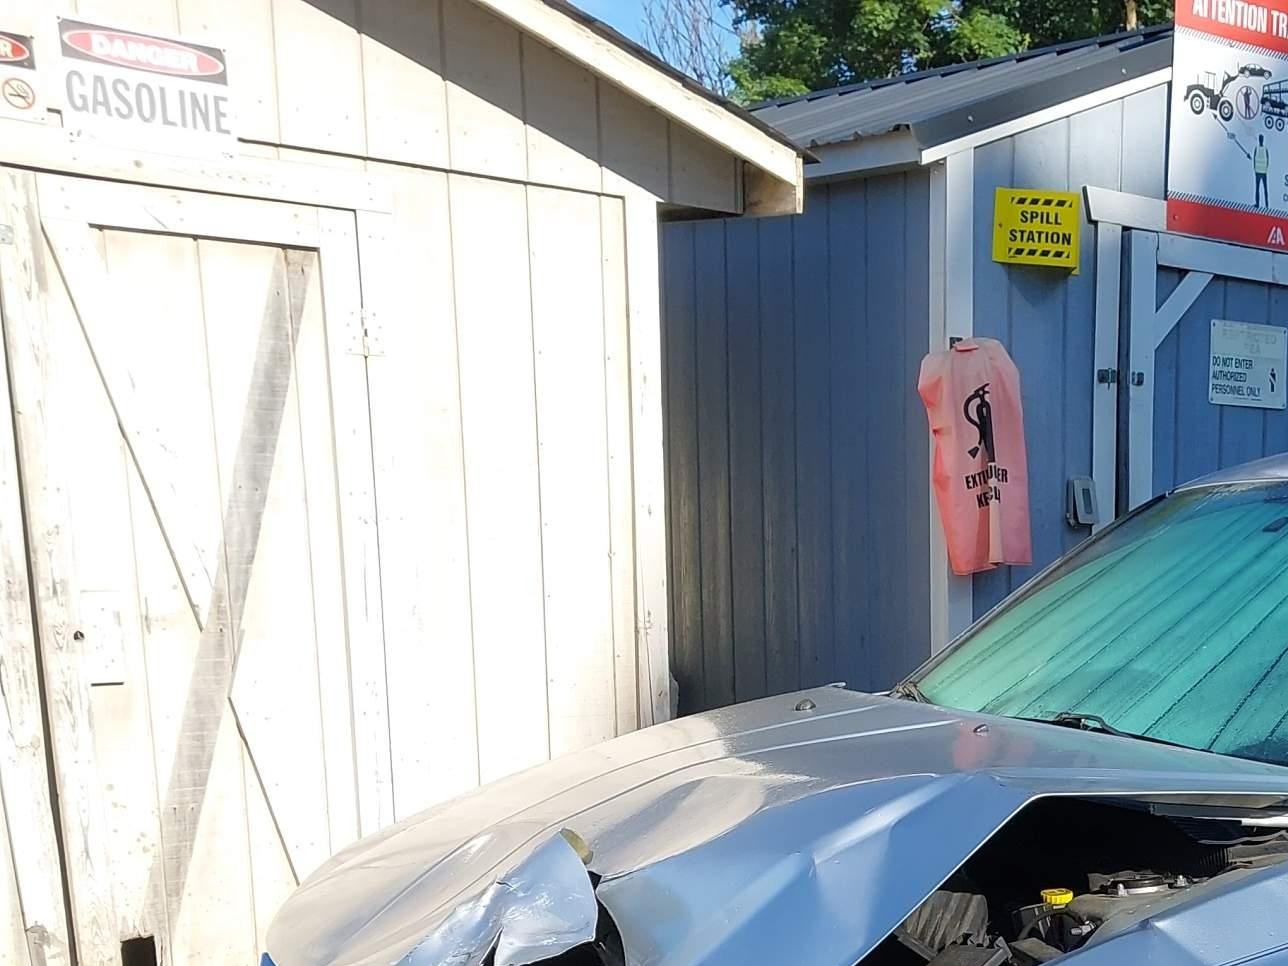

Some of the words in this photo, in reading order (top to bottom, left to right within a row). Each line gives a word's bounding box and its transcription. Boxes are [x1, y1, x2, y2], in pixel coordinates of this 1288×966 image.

[1191, 0, 1268, 34] ATTENTION
[91, 31, 200, 74] DANGER
[65, 70, 232, 135] GASOLINE
[1020, 210, 1062, 226] SPILL
[1009, 228, 1072, 246] STATION
[1212, 355, 1221, 367] DO
[1222, 357, 1234, 369] NOT
[1235, 358, 1253, 370] ENTER
[1212, 370, 1247, 383] AUTHORIZED
[1212, 383, 1246, 396] PERSONNEL
[1246, 386, 1261, 397] ONLY
